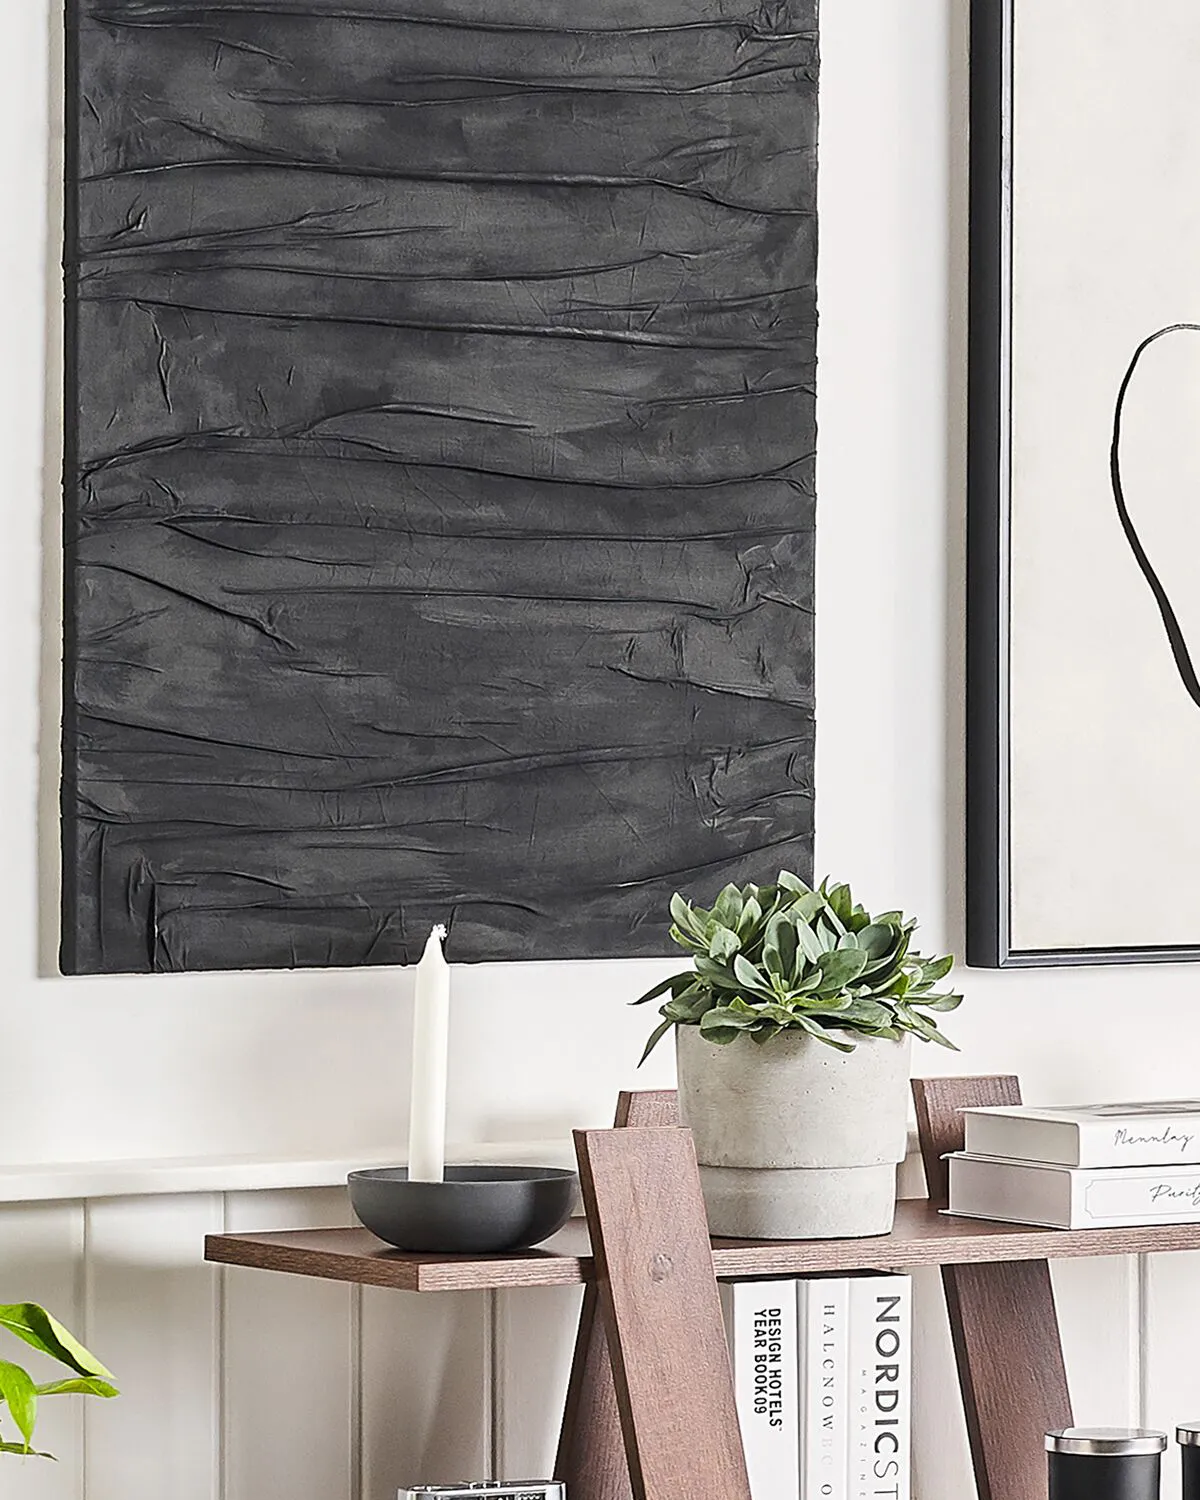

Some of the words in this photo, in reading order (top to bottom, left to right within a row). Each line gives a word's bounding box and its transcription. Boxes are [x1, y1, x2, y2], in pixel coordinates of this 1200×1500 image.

[753, 1308, 767, 1349] YEAR
[767, 1308, 782, 1364] DESIGN
[768, 1368, 783, 1428] HOTELS
[859, 1369, 868, 1497] MAGAZINE
